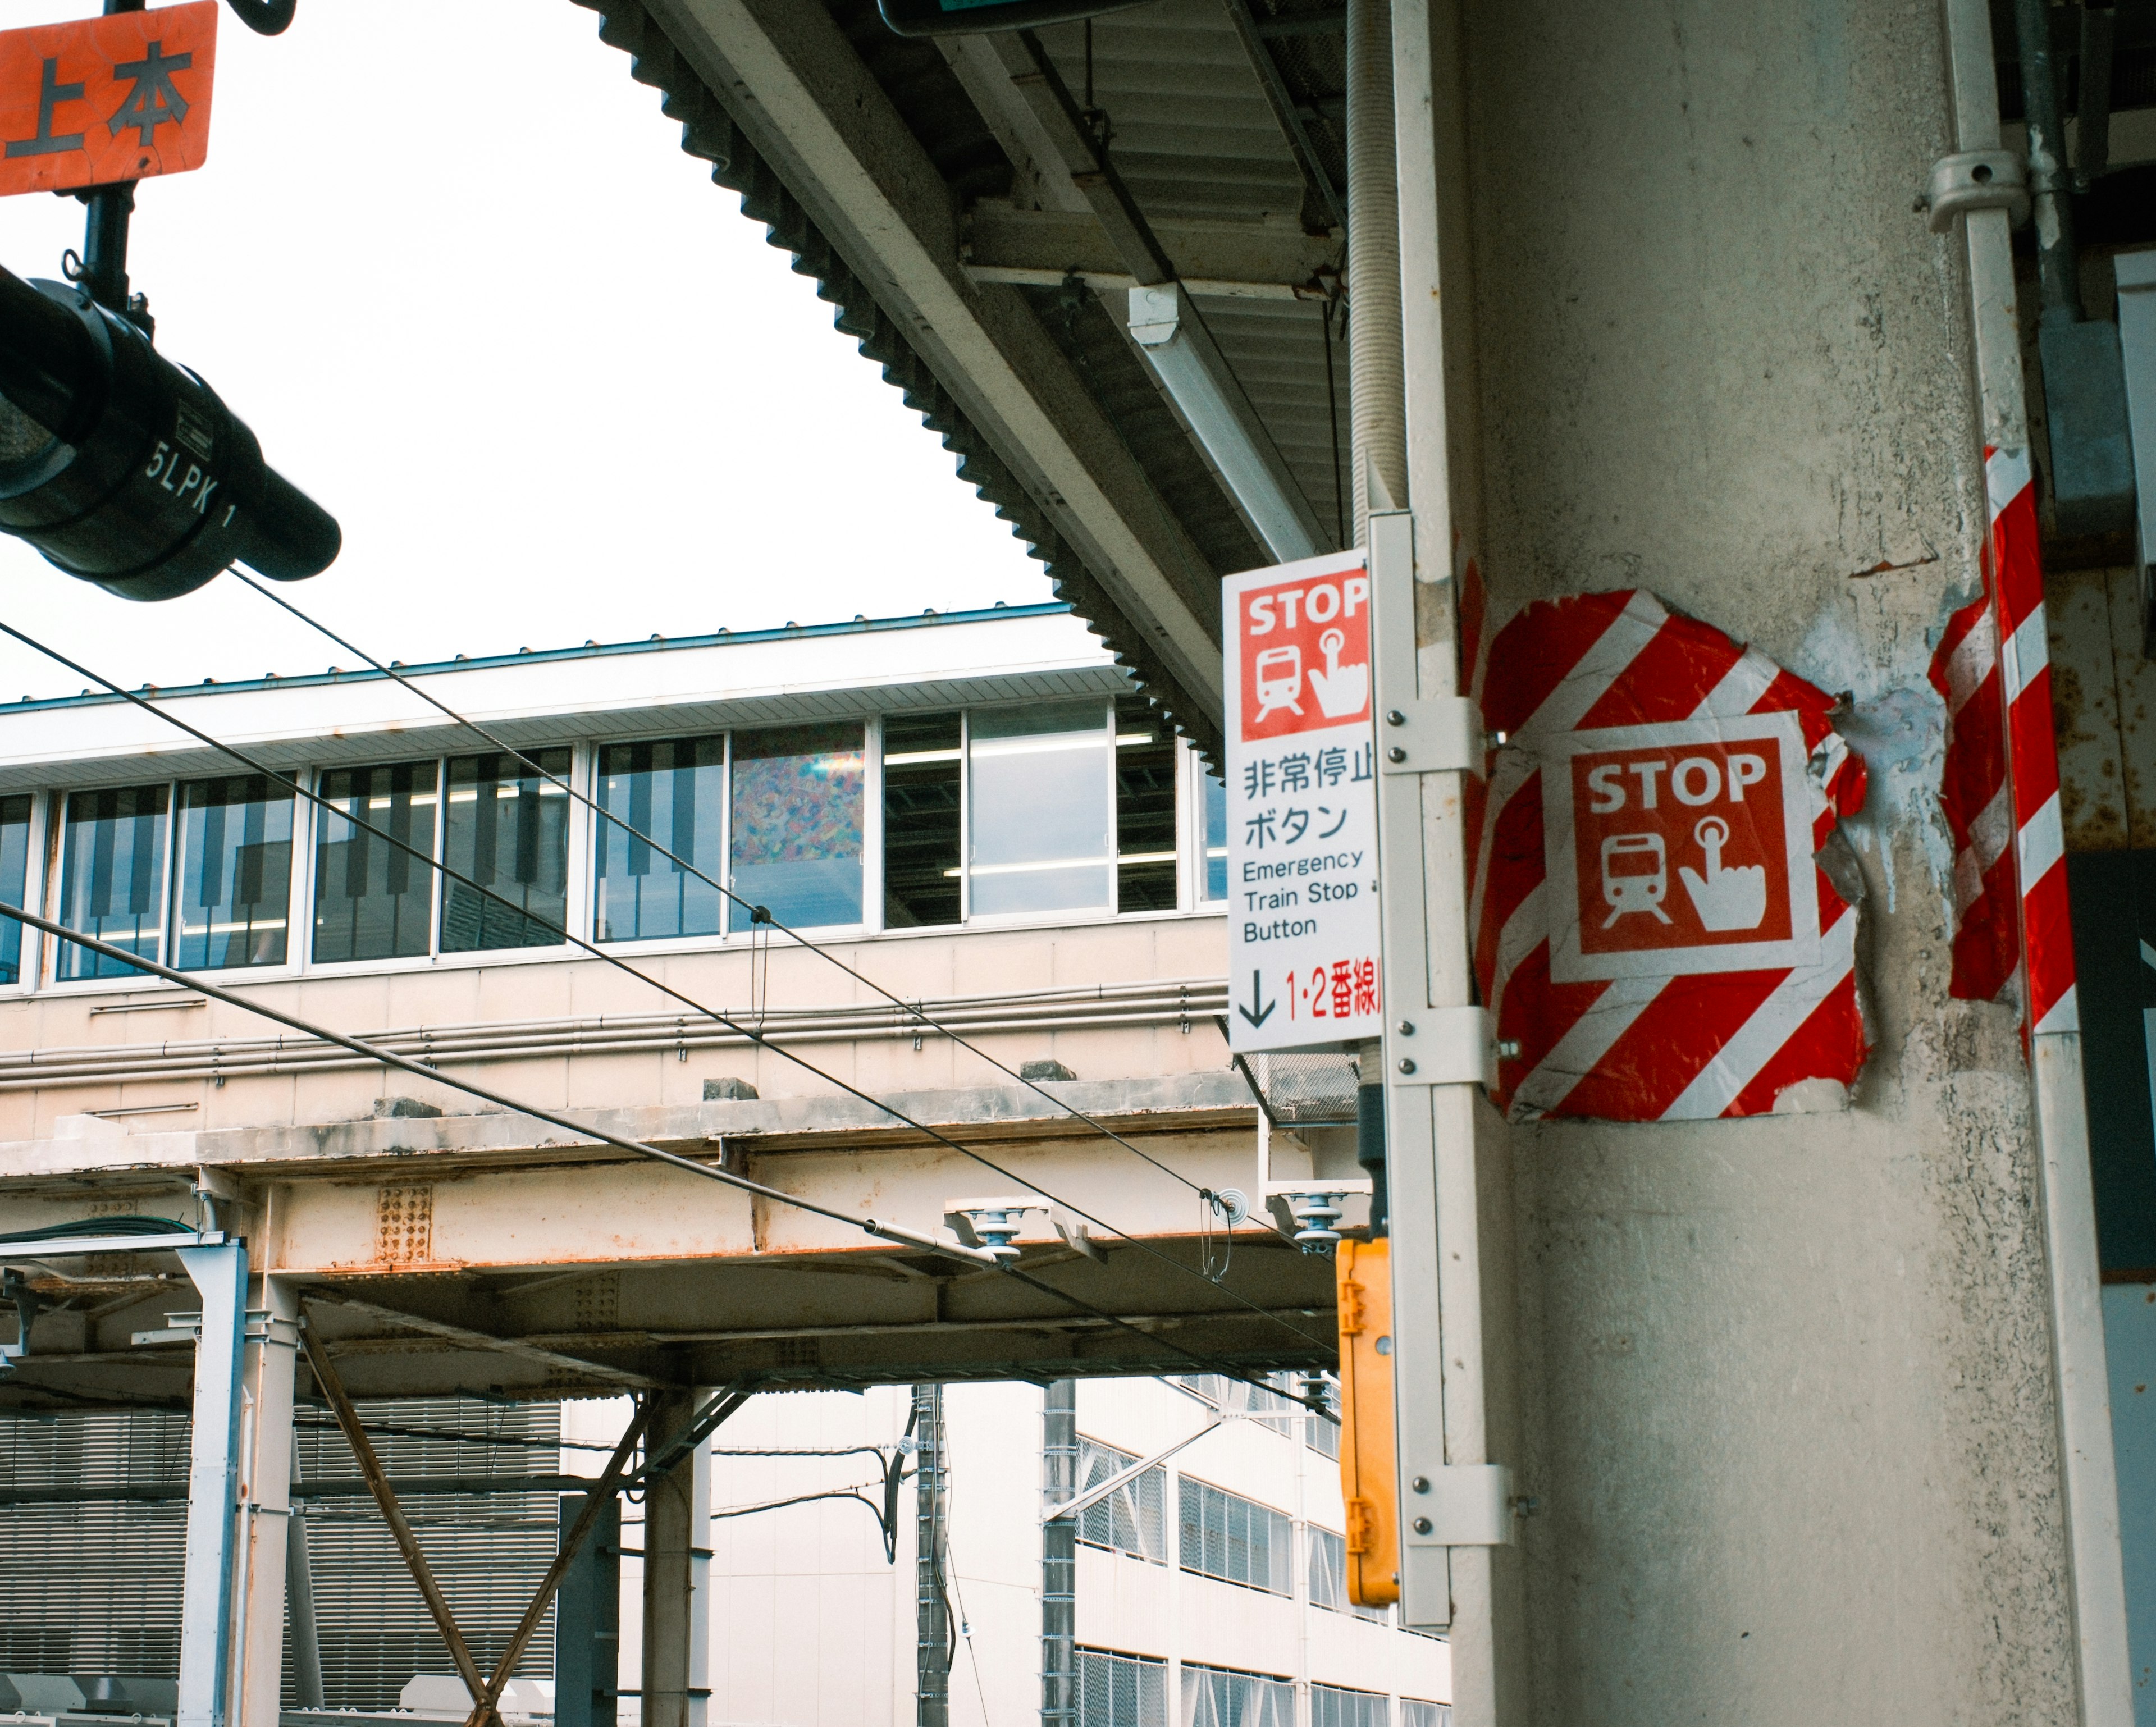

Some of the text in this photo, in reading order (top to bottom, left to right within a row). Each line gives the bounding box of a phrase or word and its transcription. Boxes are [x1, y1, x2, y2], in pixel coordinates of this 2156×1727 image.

[5, 40, 193, 159] 上本
[144, 440, 237, 528] 5LPK 1
[1249, 577, 1369, 636] STOP
[1243, 742, 1373, 801] 非常停止
[1588, 752, 1767, 815] STOP
[1245, 806, 1347, 849] ボタン
[1243, 850, 1364, 883] Emergency
[1244, 881, 1359, 912] Train Stop
[1244, 919, 1317, 943] Button
[1286, 955, 1382, 1021] 1・2番線
